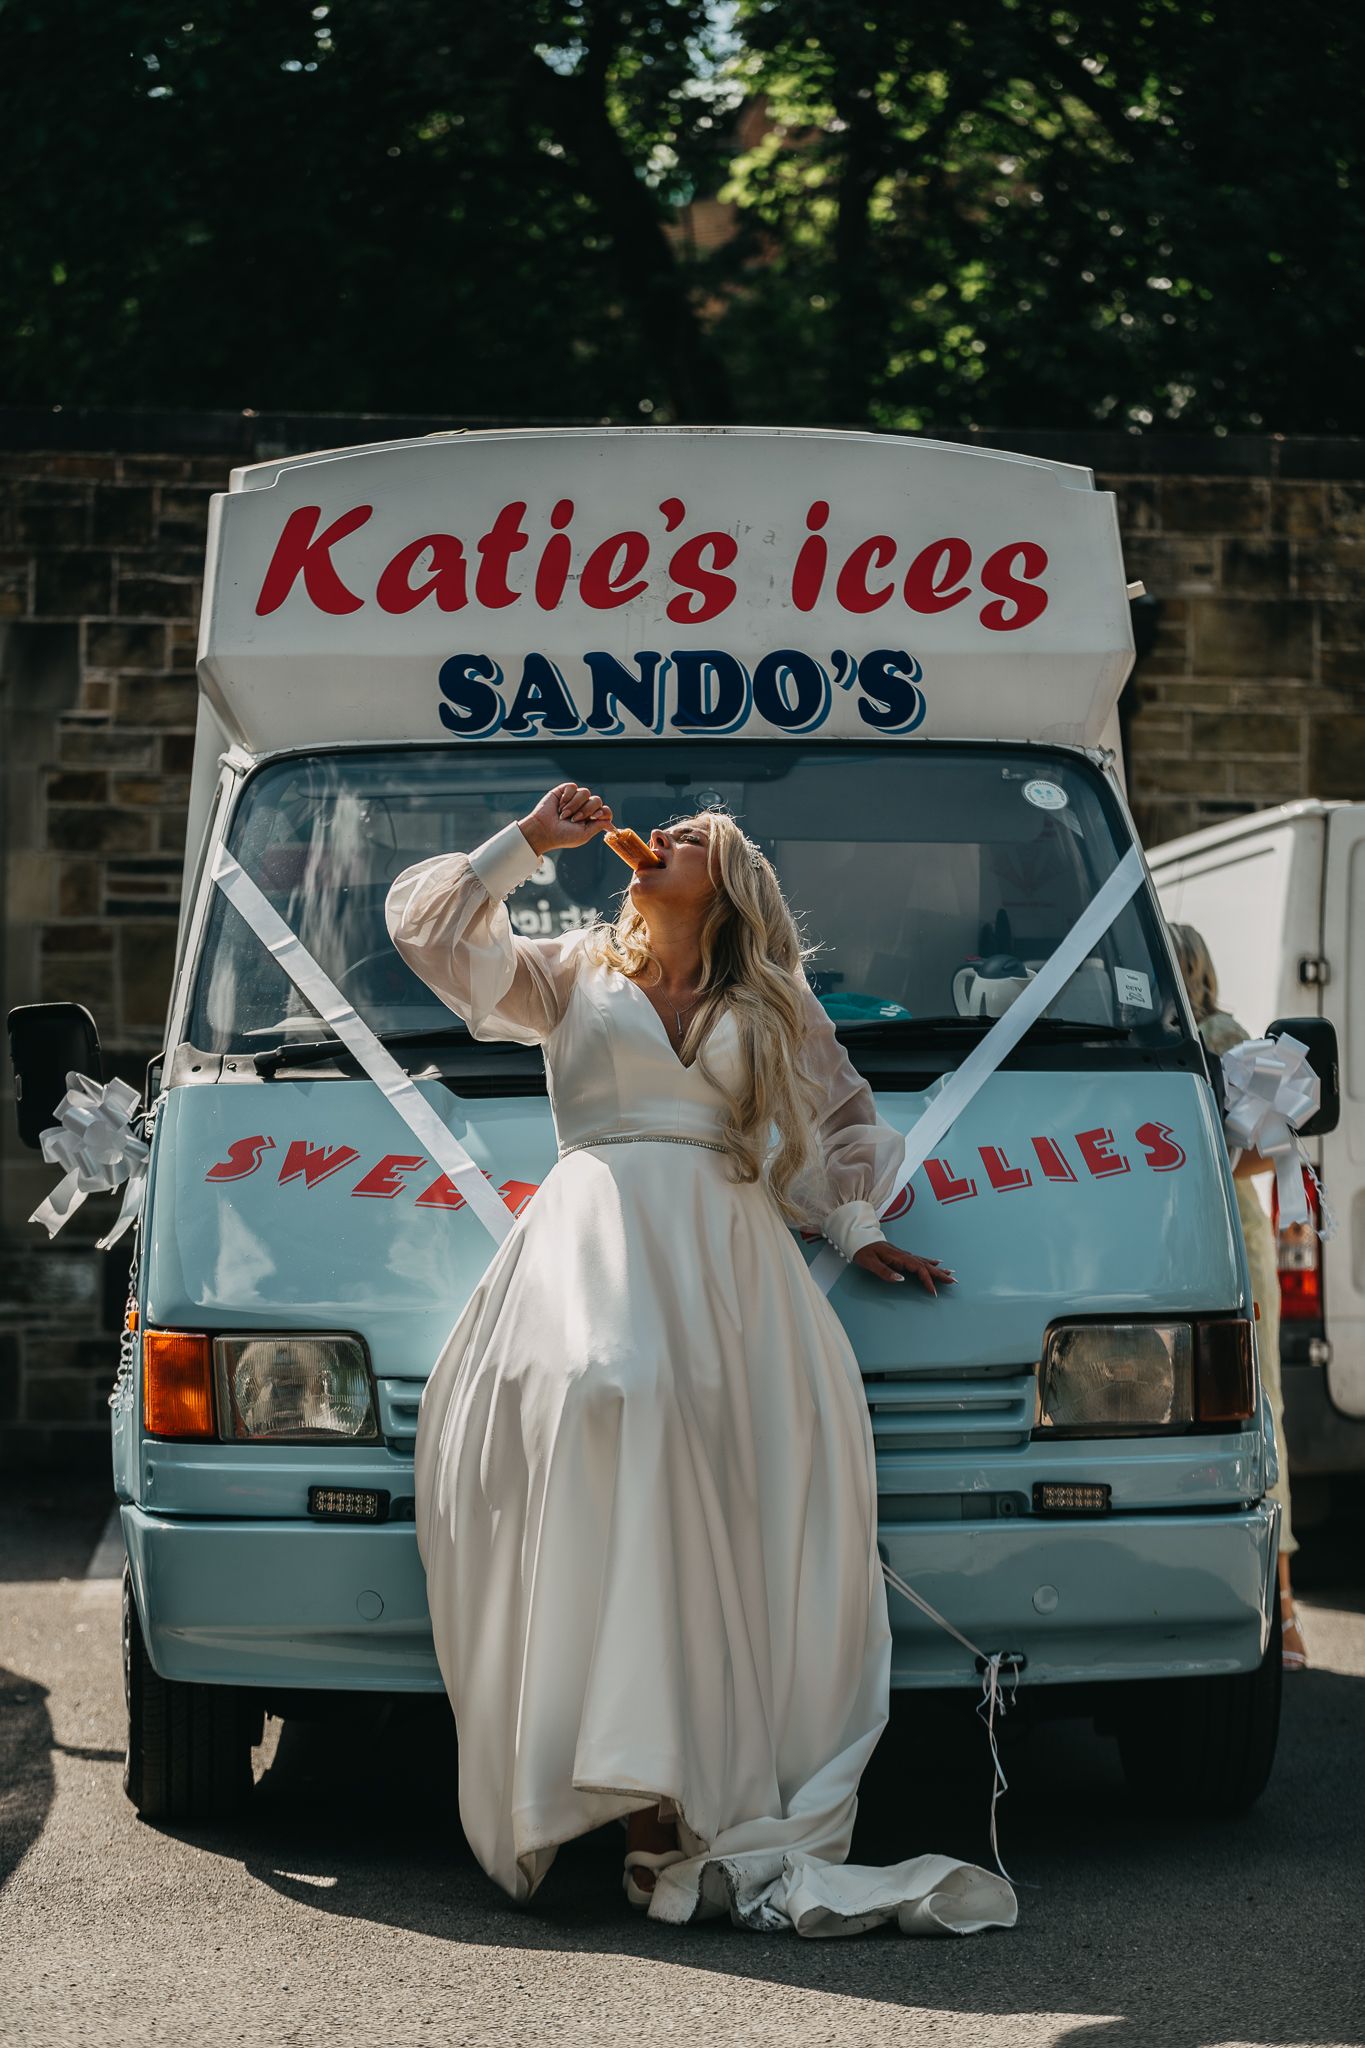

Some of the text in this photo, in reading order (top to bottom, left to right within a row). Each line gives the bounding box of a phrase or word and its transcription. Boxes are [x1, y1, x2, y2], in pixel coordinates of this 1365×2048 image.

[256, 497, 1049, 632] Katie's ices
[438, 649, 926, 736] SANDO'S
